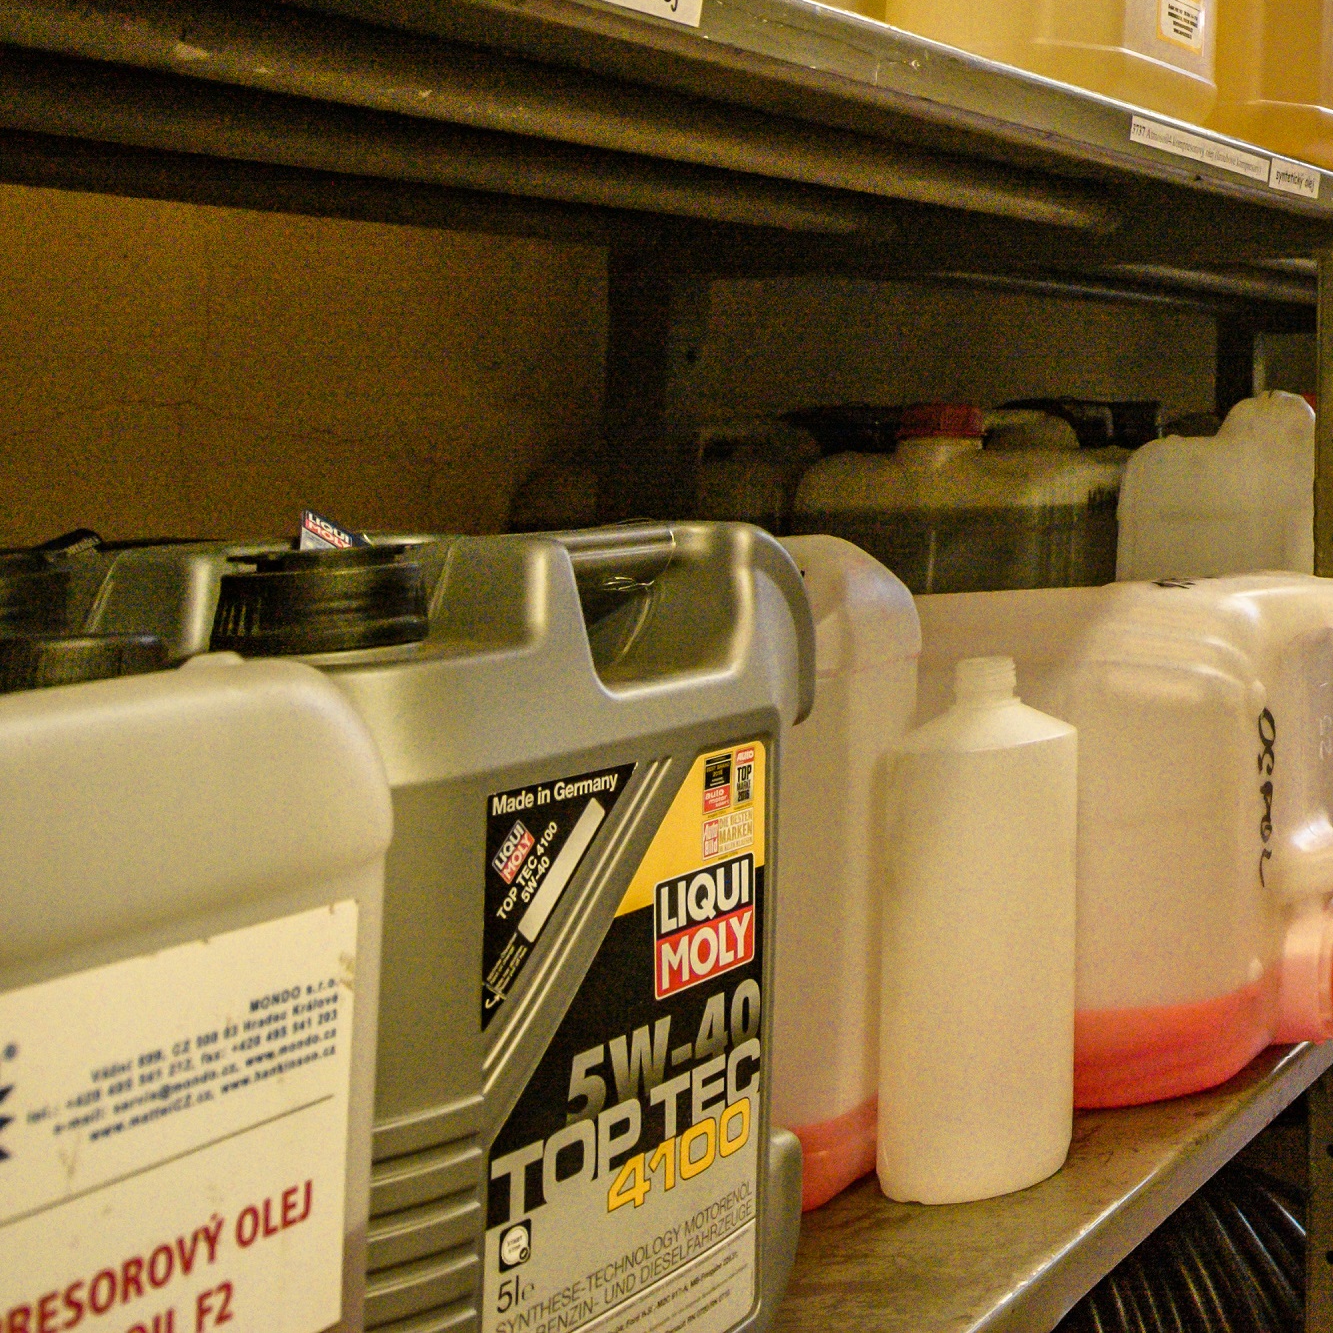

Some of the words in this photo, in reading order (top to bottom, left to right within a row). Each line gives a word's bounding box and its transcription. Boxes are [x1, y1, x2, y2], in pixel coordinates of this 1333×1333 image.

[308, 512, 350, 544] LIQUI
[492, 790, 535, 816] Made
[537, 786, 550, 805] in
[553, 773, 619, 801] Germany
[705, 788, 725, 800] auto
[737, 764, 752, 782] TOP
[493, 822, 526, 872] LIQUI
[496, 886, 519, 920] TOP
[515, 855, 538, 886] TEC
[536, 820, 558, 856] 4100
[503, 833, 534, 880] MOLY
[520, 855, 551, 903] 5W-40
[659, 858, 750, 935] LIQUI
[660, 909, 753, 991] MOLY
[249, 985, 301, 1013] MONDO
[567, 978, 761, 1119] 5W-40
[490, 1097, 643, 1228] TOP
[650, 1036, 761, 1140] TEC
[607, 1095, 752, 1214] 4100
[0, 1212, 225, 1333] RESOROVÝ
[235, 1178, 313, 1249] OLEJ
[494, 1225, 682, 1333] SYNTHESE-TECHNOLOGY
[603, 1273, 637, 1304] UND
[638, 1198, 754, 1284] DIESELFAHRZEUGE
